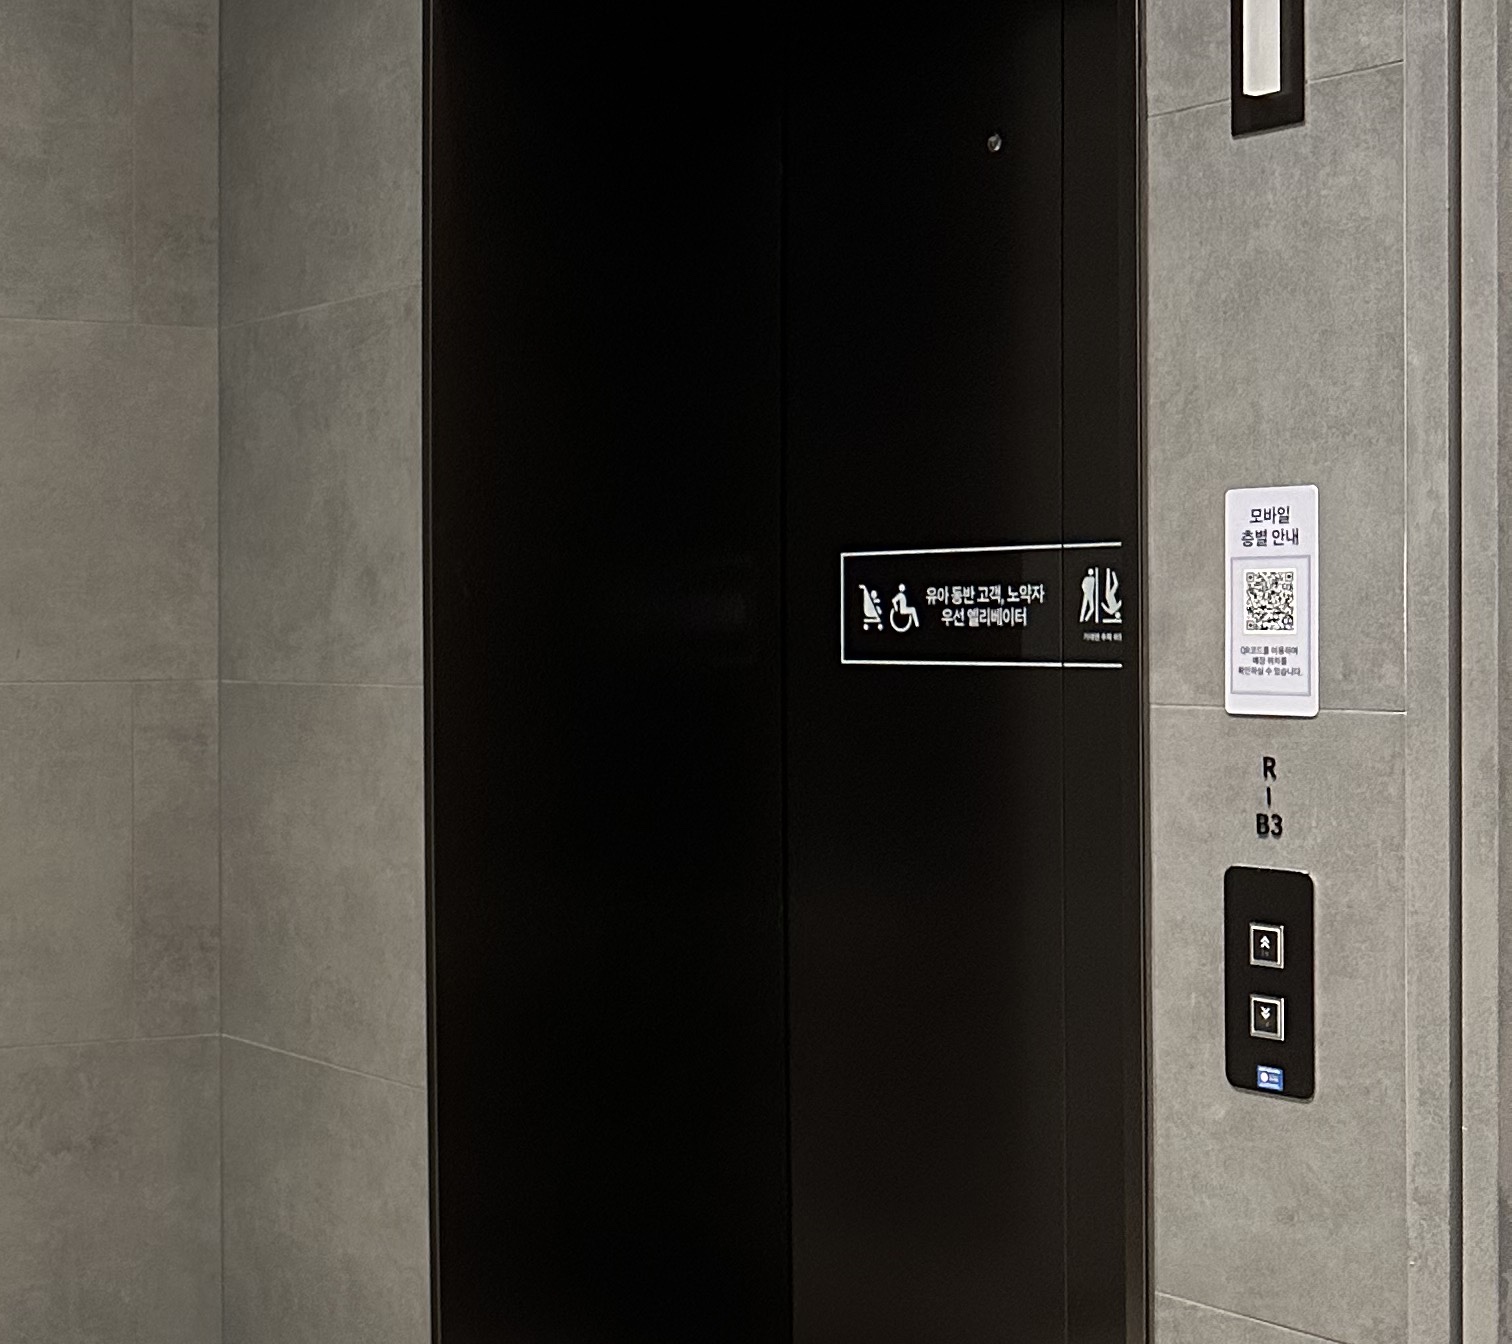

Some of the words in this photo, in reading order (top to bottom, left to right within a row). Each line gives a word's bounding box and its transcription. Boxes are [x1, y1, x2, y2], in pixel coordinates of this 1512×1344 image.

[1249, 505, 1290, 525] 모바일
[1241, 529, 1267, 547] 층별
[1272, 528, 1299, 546] 안내
[926, 585, 949, 605] 유아
[951, 585, 975, 605] 동반
[977, 584, 1005, 606] 고객,
[1007, 584, 1045, 604] 노약자
[941, 608, 965, 627] 우선
[1263, 756, 1277, 782] R
[1256, 813, 1283, 839] B3
